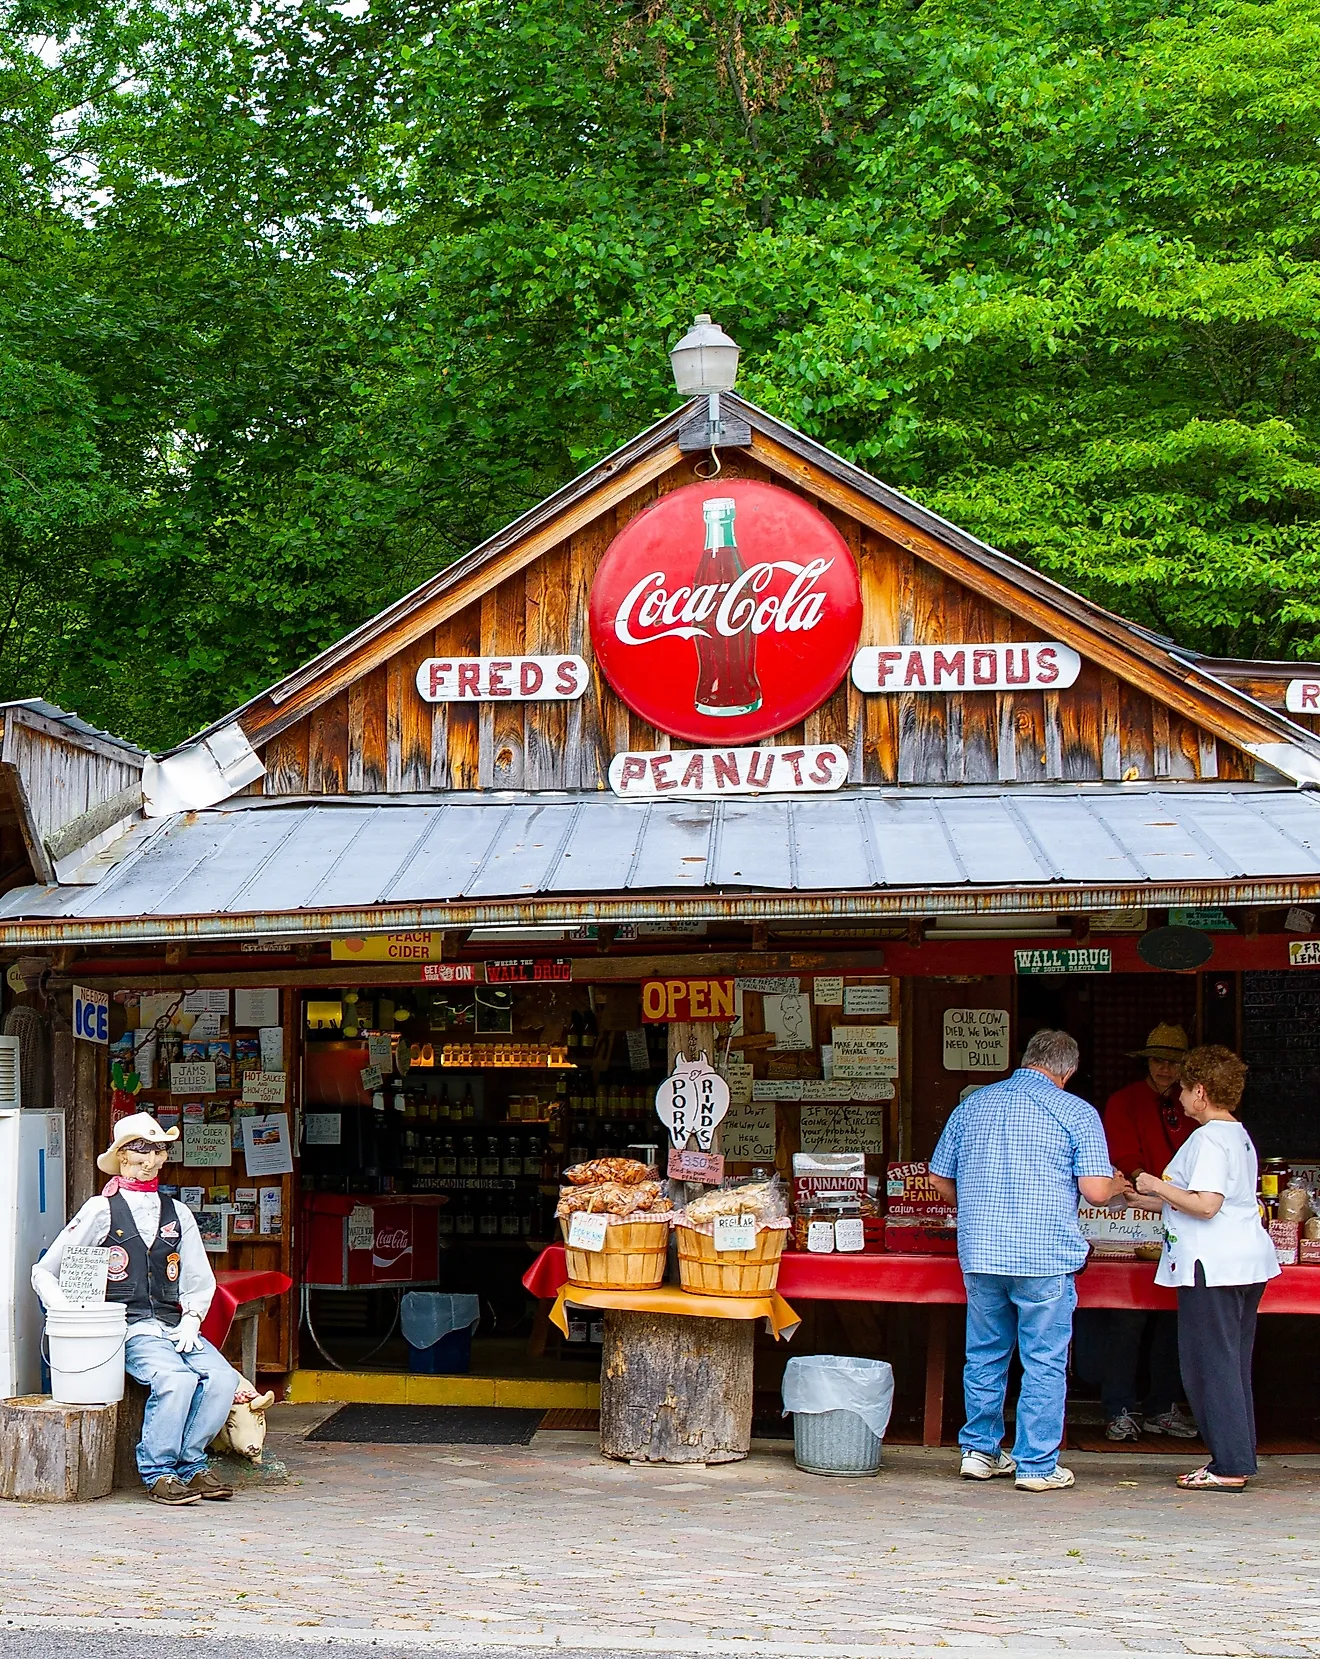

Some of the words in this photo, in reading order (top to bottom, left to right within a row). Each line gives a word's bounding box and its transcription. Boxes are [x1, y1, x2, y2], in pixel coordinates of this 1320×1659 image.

[615, 556, 835, 646] Coca-Cola
[878, 648, 1060, 686] FAMOUS
[620, 751, 836, 792] PEANUTS
[388, 932, 431, 943] PEACH
[388, 945, 430, 959] CIDER
[1017, 950, 1062, 968] WALL
[1068, 948, 1110, 966] DRUG
[424, 965, 438, 975] GET
[455, 965, 471, 981] ON
[487, 965, 528, 981] WALL
[533, 964, 570, 980] DRUG
[643, 981, 735, 1018] OPEN
[76, 999, 107, 1040] ICE
[952, 1011, 976, 1024] OUR
[979, 1012, 1002, 1025] COW
[834, 1041, 851, 1050] MAKE
[945, 1040, 968, 1049] NEED
[975, 1040, 1003, 1049] YOUR
[968, 1051, 1000, 1066] BULL
[172, 1076, 207, 1086] JELLIES
[245, 1071, 261, 1081] HOT
[262, 1074, 286, 1083] SAUCES
[242, 1086, 282, 1096] CHOW-CHOW
[672, 1079, 687, 1142] PORK
[700, 1079, 713, 1143] RINDS
[807, 1106, 821, 1117] IF
[203, 1128, 223, 1137] CIDER
[738, 1134, 760, 1142] HERE
[187, 1137, 202, 1145] CAN
[203, 1137, 226, 1146] DRINKS
[733, 1144, 750, 1156] US
[887, 1162, 926, 1181] FRED'S
[798, 1177, 865, 1191] CINNAMON
[903, 1191, 942, 1202] PEANU
[888, 1203, 915, 1214] cajun
[719, 1217, 754, 1228] REGAR
[67, 1246, 90, 1256] PLEASE
